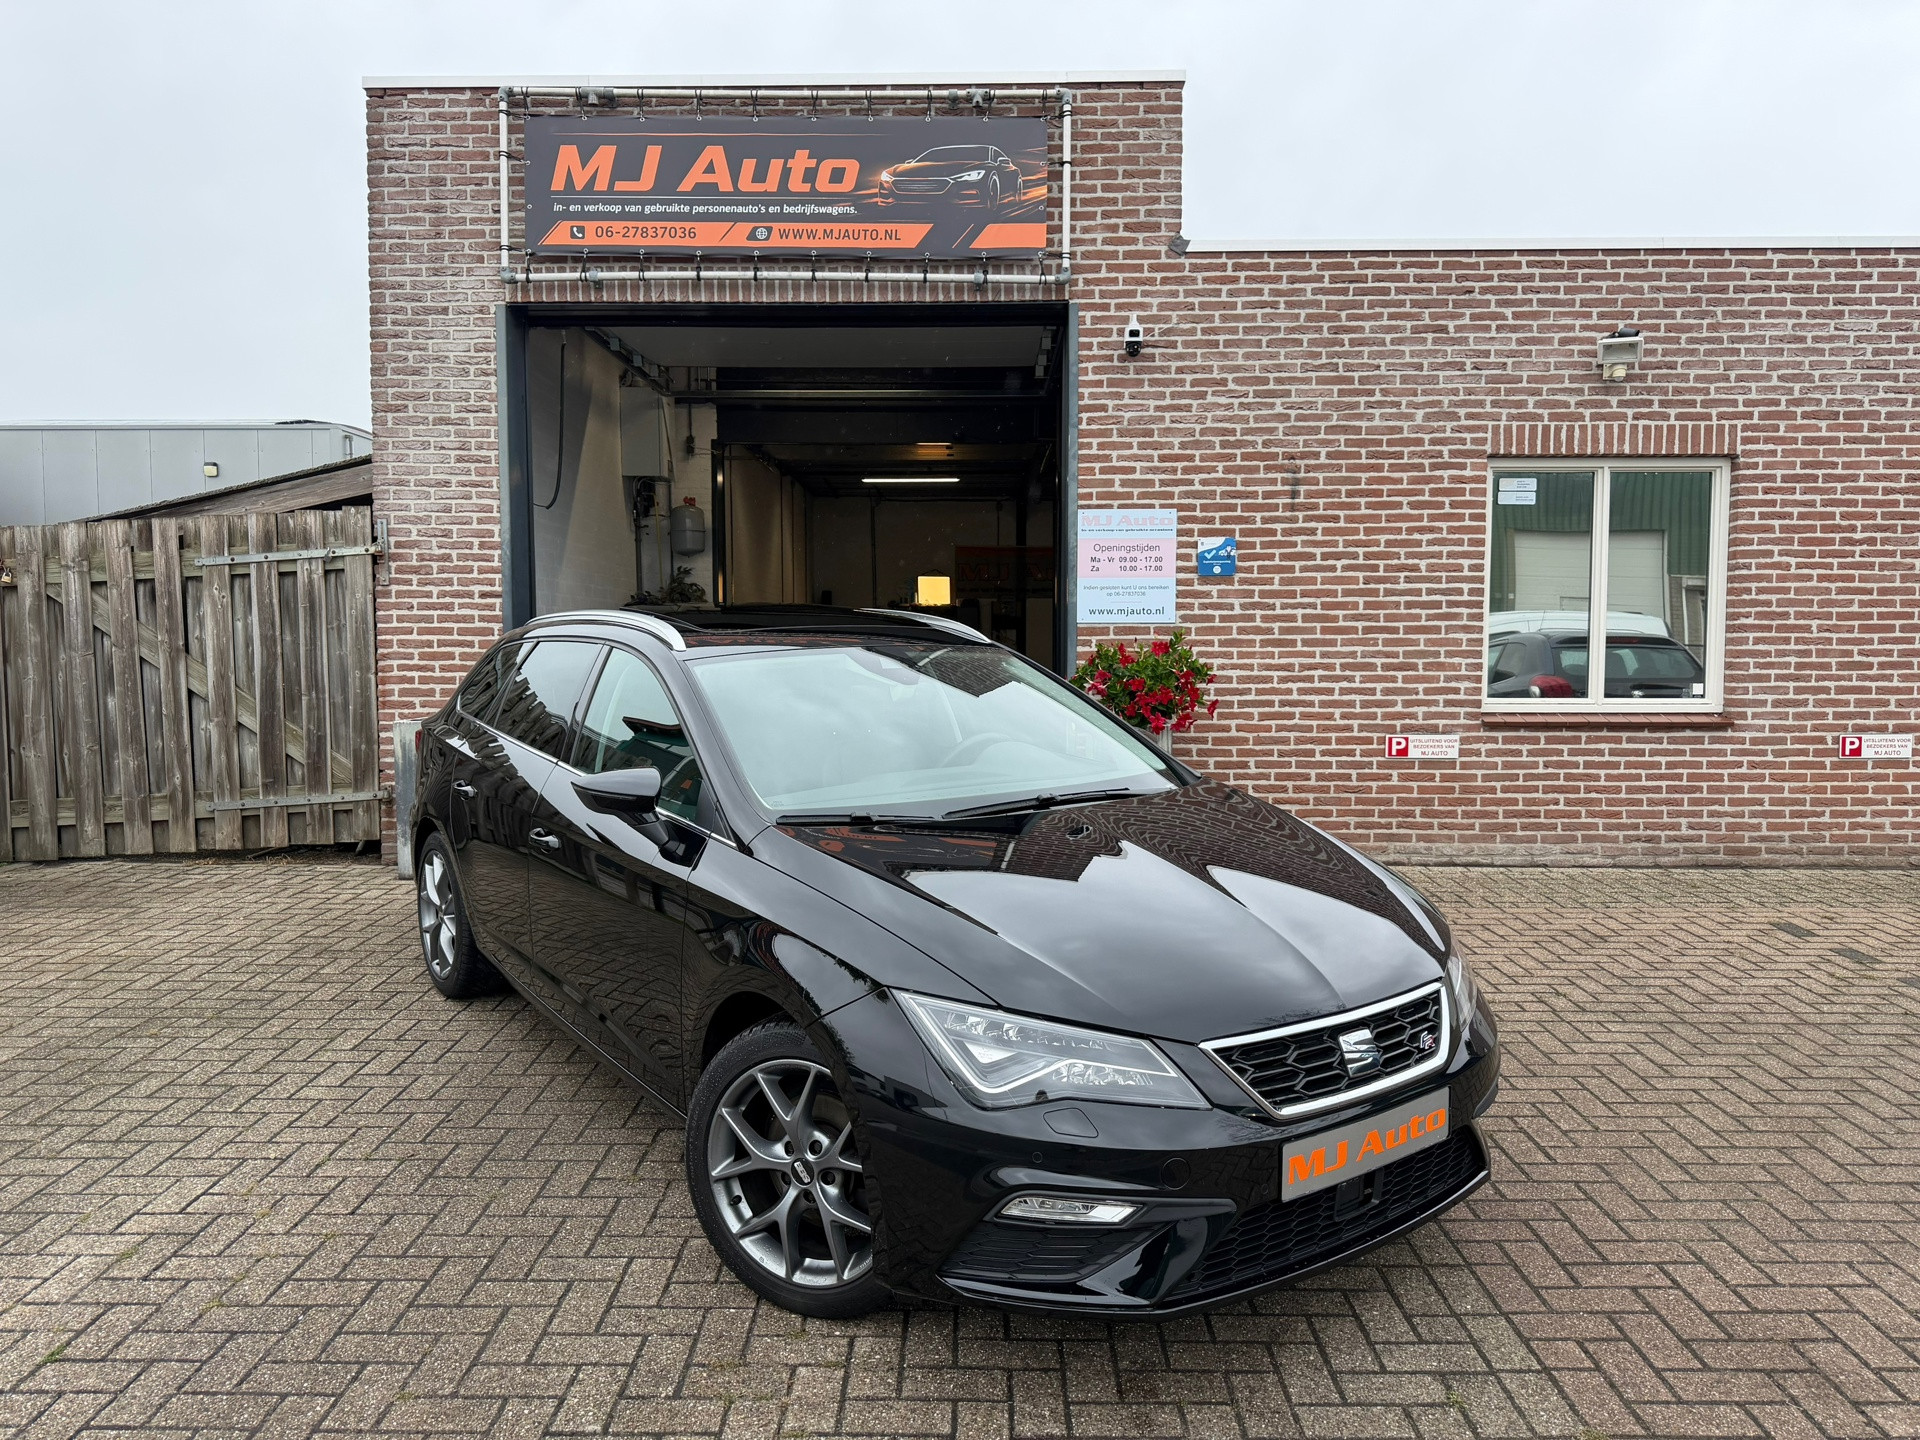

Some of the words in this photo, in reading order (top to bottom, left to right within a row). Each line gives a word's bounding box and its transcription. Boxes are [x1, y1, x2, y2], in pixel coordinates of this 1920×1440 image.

[550, 145, 663, 191] MJ
[676, 145, 860, 192] Auto
[553, 202, 567, 212] in-
[569, 204, 581, 212] en
[584, 203, 622, 213] verkoop
[644, 203, 690, 214] gebruikte
[692, 203, 766, 215] personenauto's
[783, 204, 858, 215] bedrijfswagens.
[595, 226, 697, 239] 06-27837036
[778, 228, 902, 241] WWW.MJAUTO.NL
[1081, 515, 1112, 526] MJ
[1117, 515, 1174, 526] Auto
[1093, 543, 1161, 553] Openingstijden
[1089, 606, 1165, 617] www.mjauto.nl
[1391, 738, 1406, 755] P
[1845, 738, 1860, 755] P
[1288, 1139, 1349, 1185] MJ
[1356, 1108, 1446, 1162] Auto
